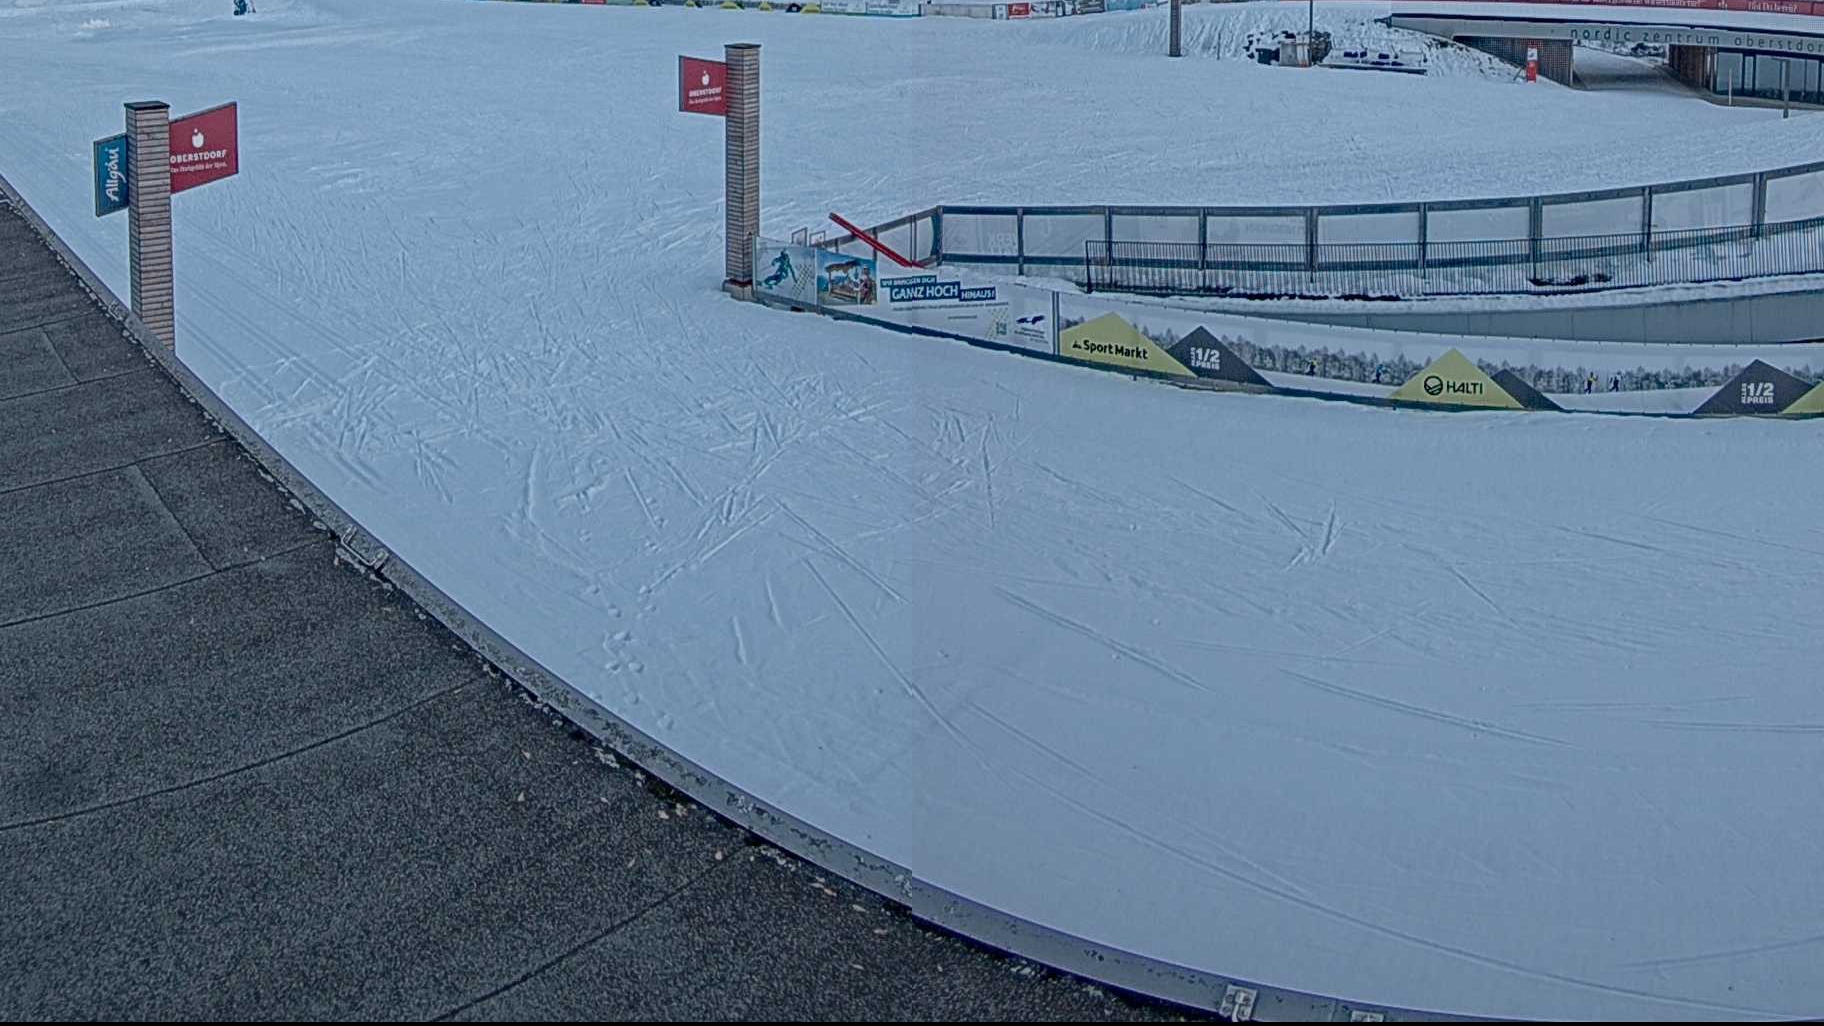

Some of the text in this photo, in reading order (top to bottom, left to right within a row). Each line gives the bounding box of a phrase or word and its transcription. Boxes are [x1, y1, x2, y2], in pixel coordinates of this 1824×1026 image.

[1570, 27, 1631, 41] nordic
[1642, 31, 1720, 44] zentrum
[170, 150, 228, 164] OBERSTDORF
[926, 285, 958, 297] HOCH
[1083, 340, 1148, 360] Sport Markt
[1196, 348, 1220, 362] 1/2
[1446, 380, 1483, 394] HALTI
[1747, 382, 1774, 396] 1/2
